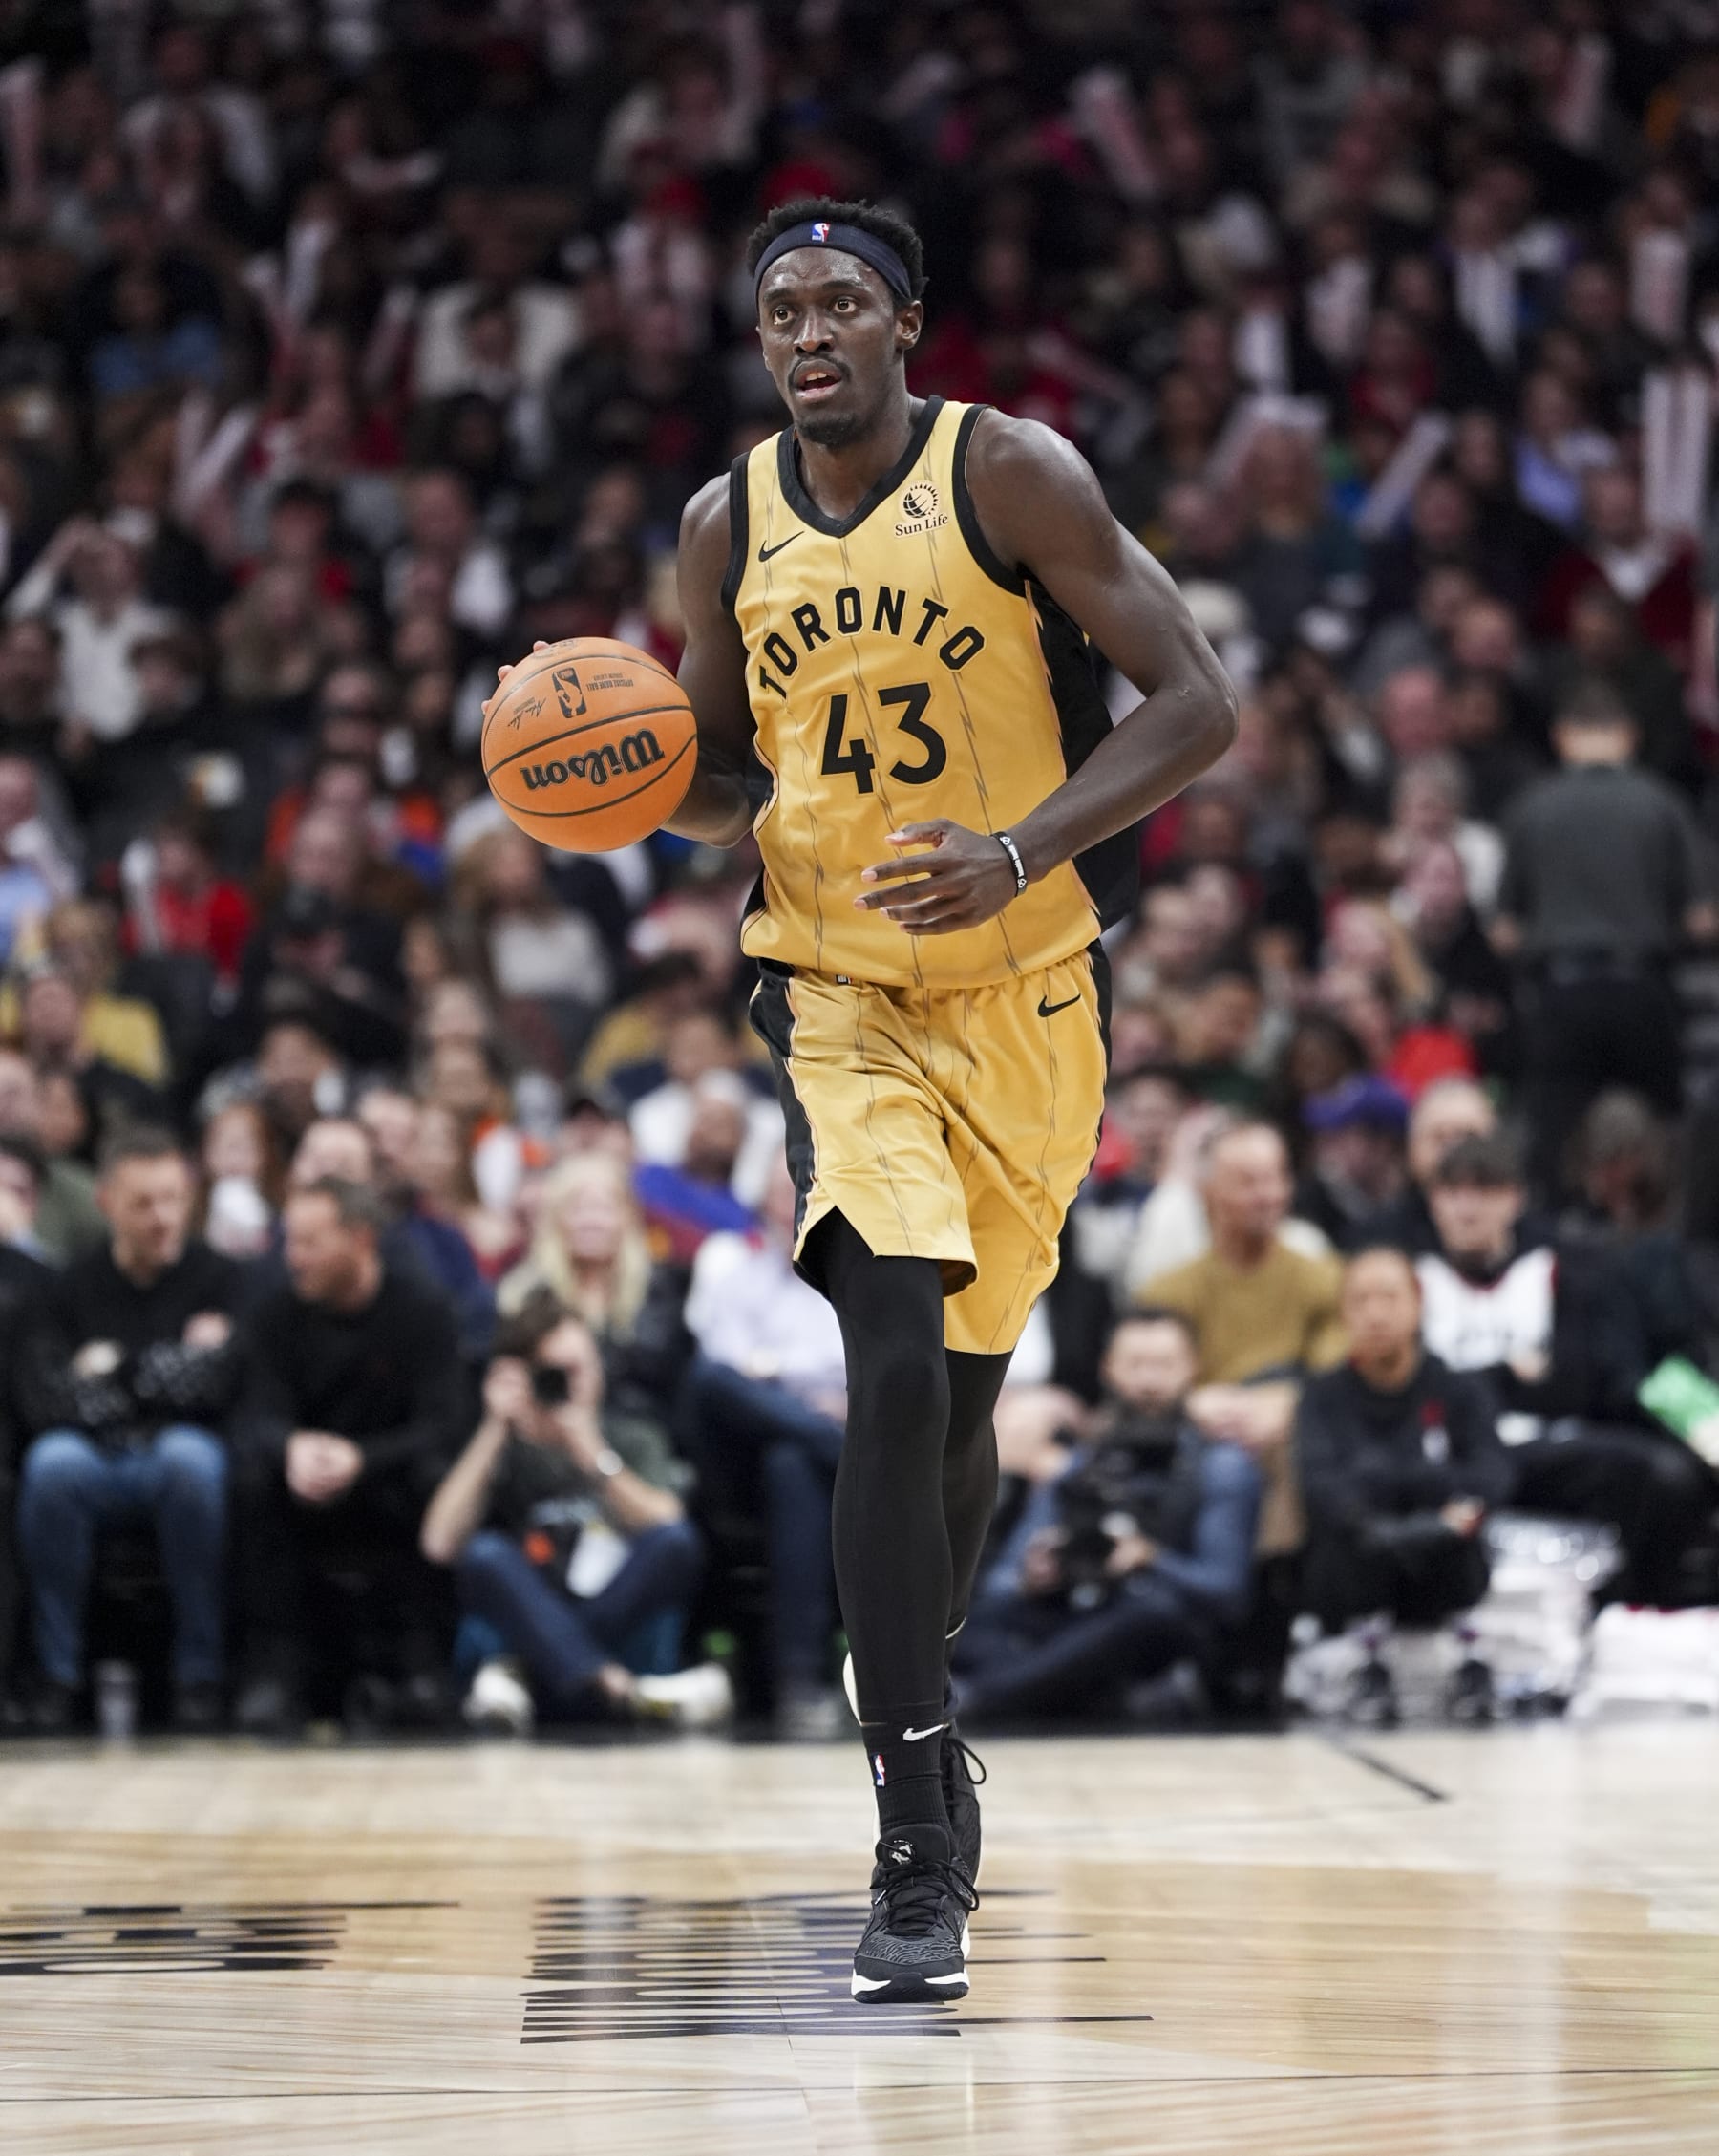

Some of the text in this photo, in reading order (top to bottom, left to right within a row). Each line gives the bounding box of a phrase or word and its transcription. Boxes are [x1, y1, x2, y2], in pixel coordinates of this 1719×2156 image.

[895, 513, 948, 537] Sun Life
[759, 586, 986, 700] TORONTO
[519, 728, 666, 791] Wilson
[821, 681, 947, 795] 43
